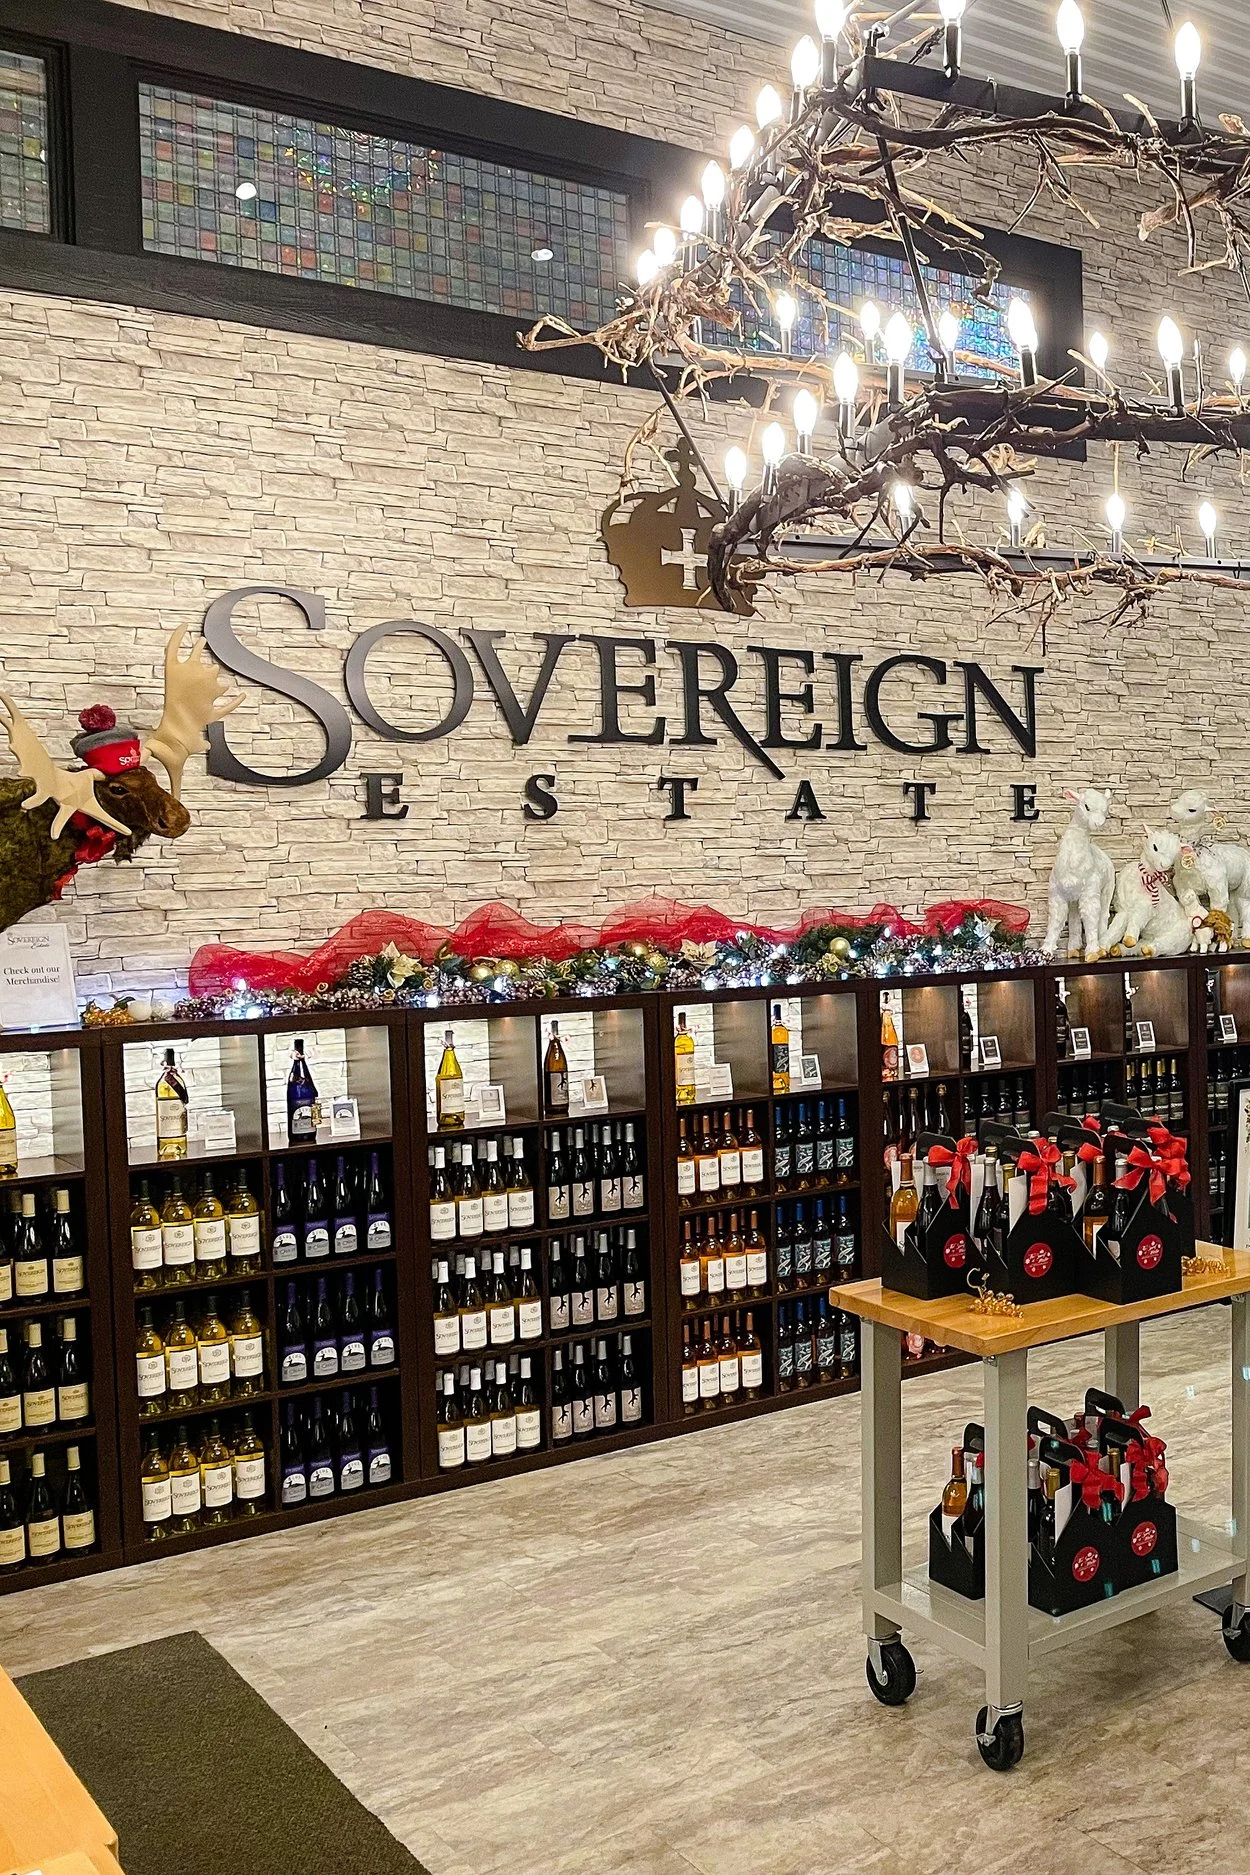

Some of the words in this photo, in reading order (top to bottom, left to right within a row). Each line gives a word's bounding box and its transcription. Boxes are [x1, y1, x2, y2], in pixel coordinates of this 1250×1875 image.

[203, 586, 1044, 787] SOVEREIGN
[360, 772, 1040, 823] ESTATE
[7, 935, 50, 946] SOVEREIGN
[3, 966, 29, 975] Check
[31, 966, 44, 974] out
[6, 975, 60, 986] Merchandise!
